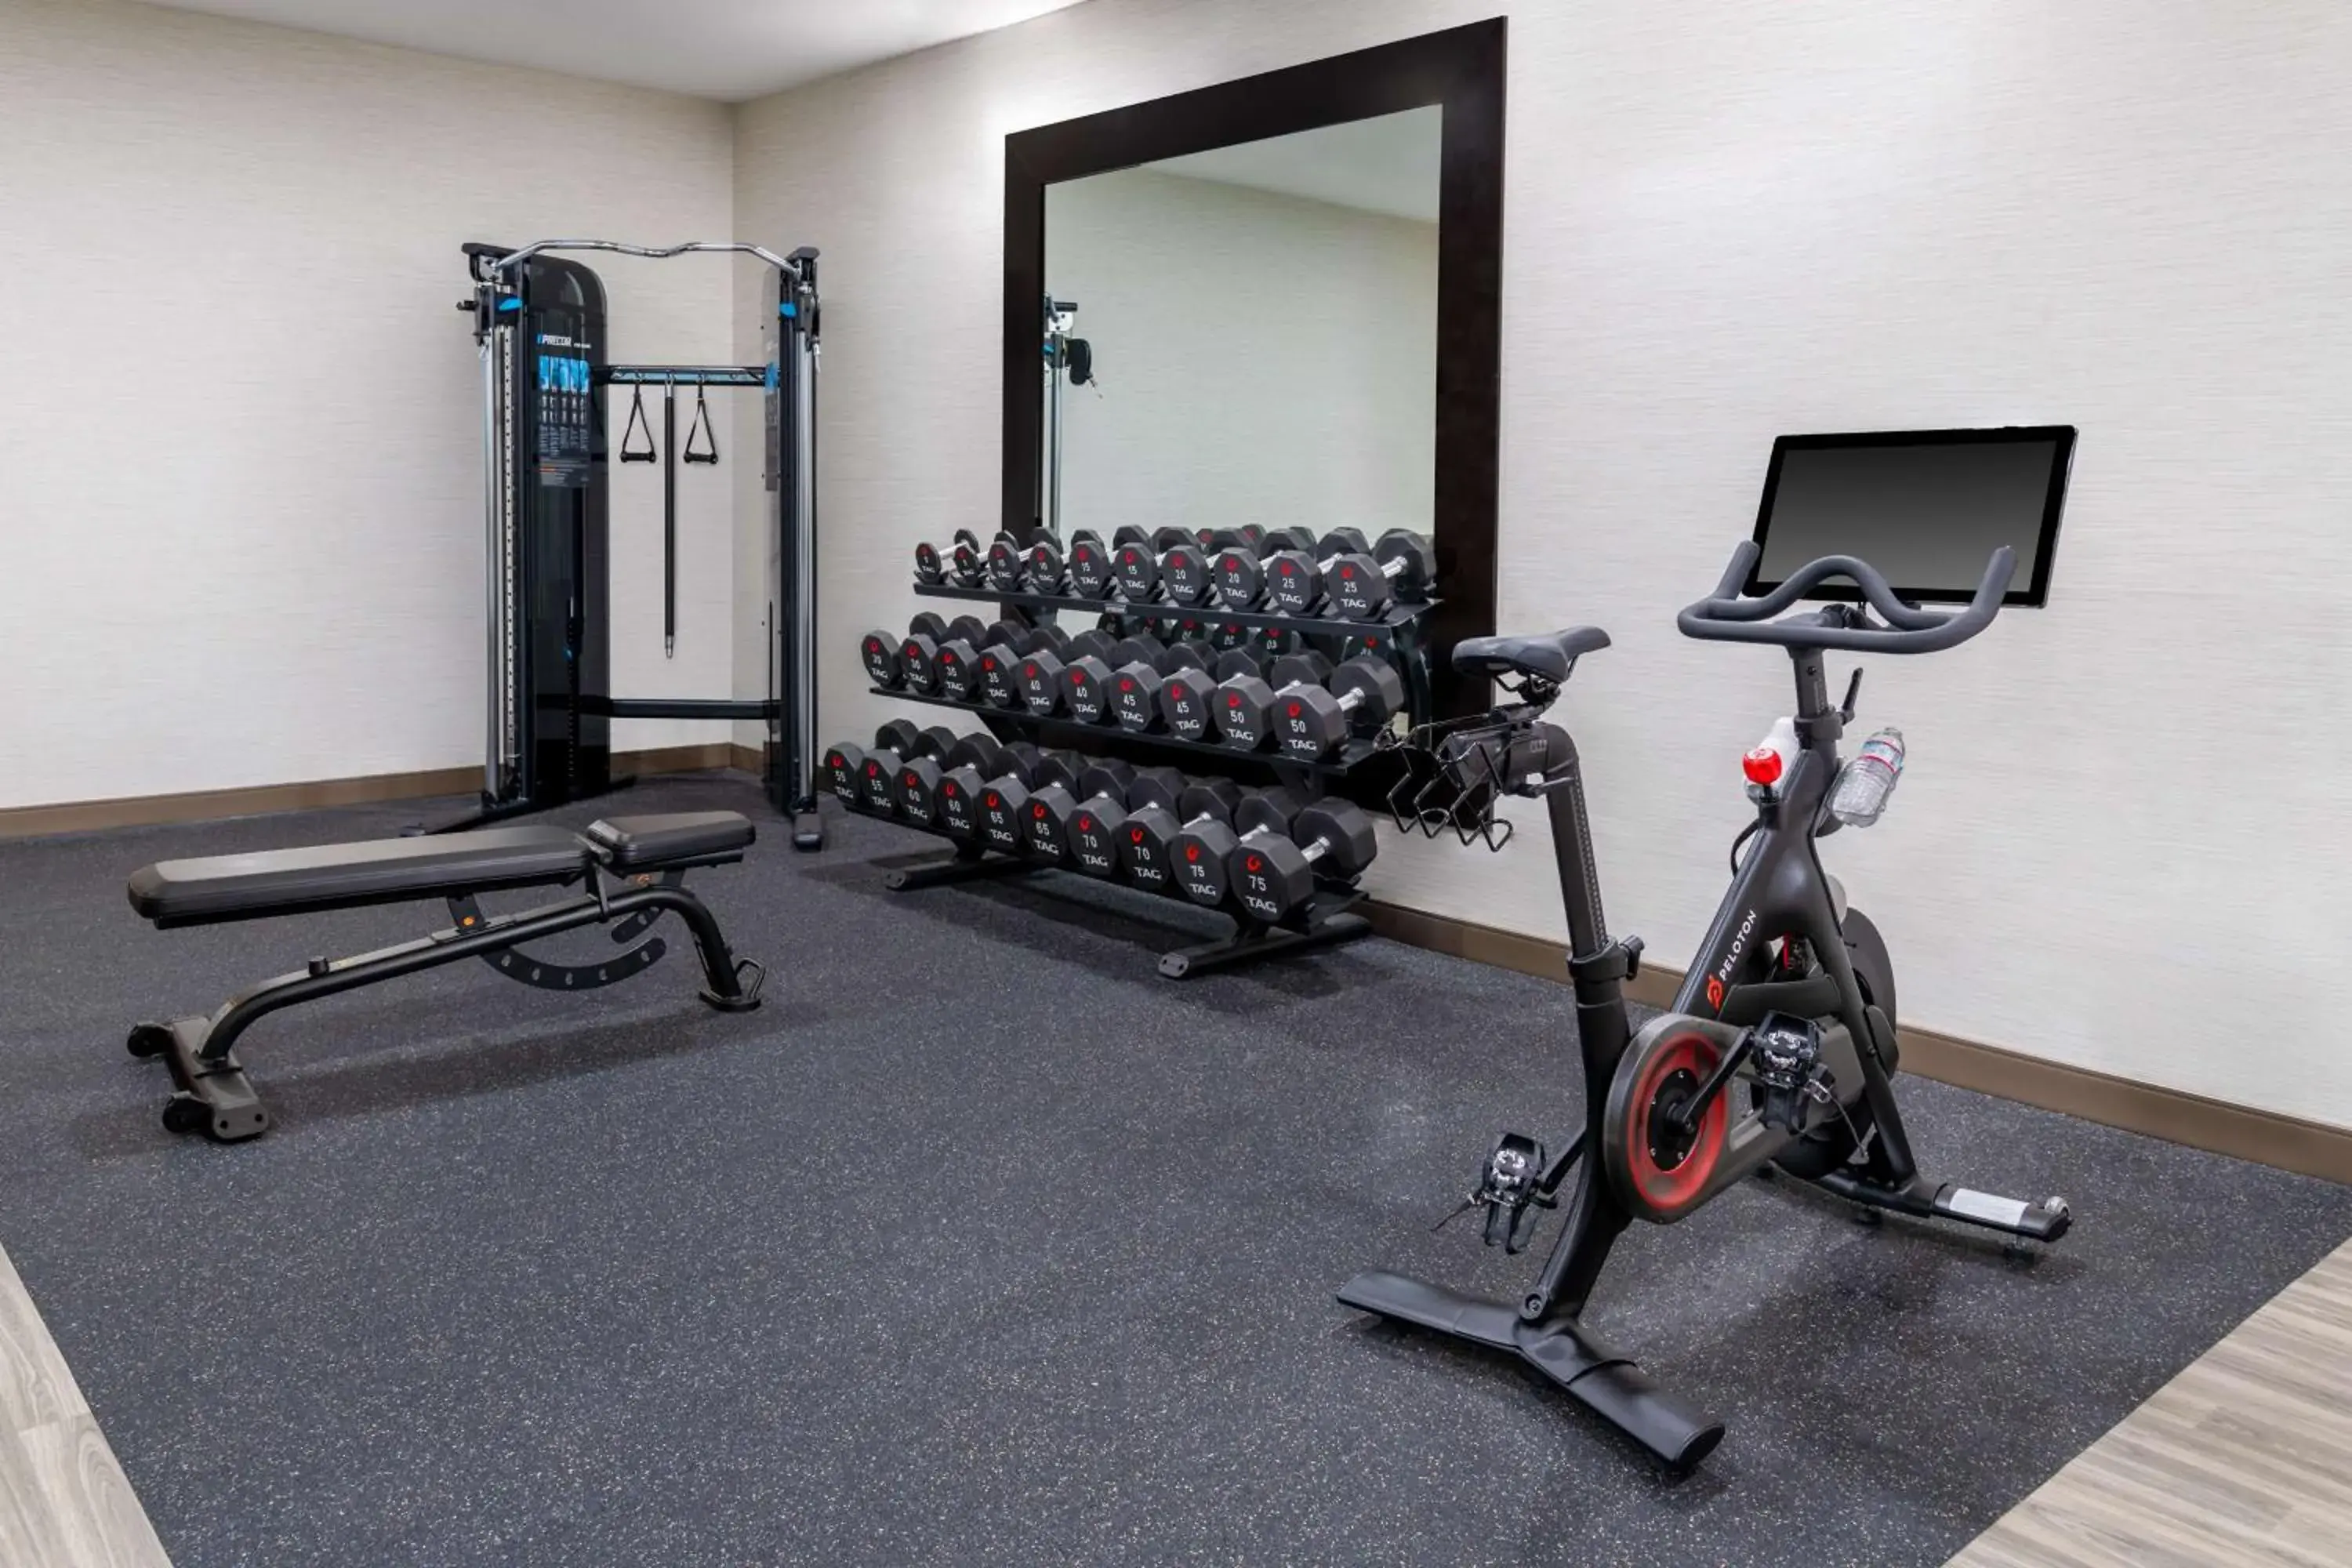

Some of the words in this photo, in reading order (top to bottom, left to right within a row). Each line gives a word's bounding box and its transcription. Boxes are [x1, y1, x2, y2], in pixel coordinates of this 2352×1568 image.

[1282, 577, 1295, 589] 25
[1279, 593, 1303, 604] TAG
[1341, 598, 1367, 608] TAG
[1120, 710, 1144, 724] TAG
[1229, 710, 1245, 724] 50
[1175, 719, 1200, 731] TAG
[1290, 719, 1306, 733] 50
[1226, 728, 1254, 742] TAG
[1288, 739, 1317, 751] TAG
[1033, 839, 1059, 855] TAG
[1082, 834, 1098, 848] 70
[1082, 854, 1109, 866] TAG
[1134, 846, 1151, 861] 70
[1134, 866, 1162, 880] TAG
[1189, 865, 1205, 877] 75
[1189, 883, 1217, 896] TAG
[1248, 874, 1267, 891] 75
[1246, 895, 1277, 914] TAG
[1719, 909, 1757, 981] PELOTON
